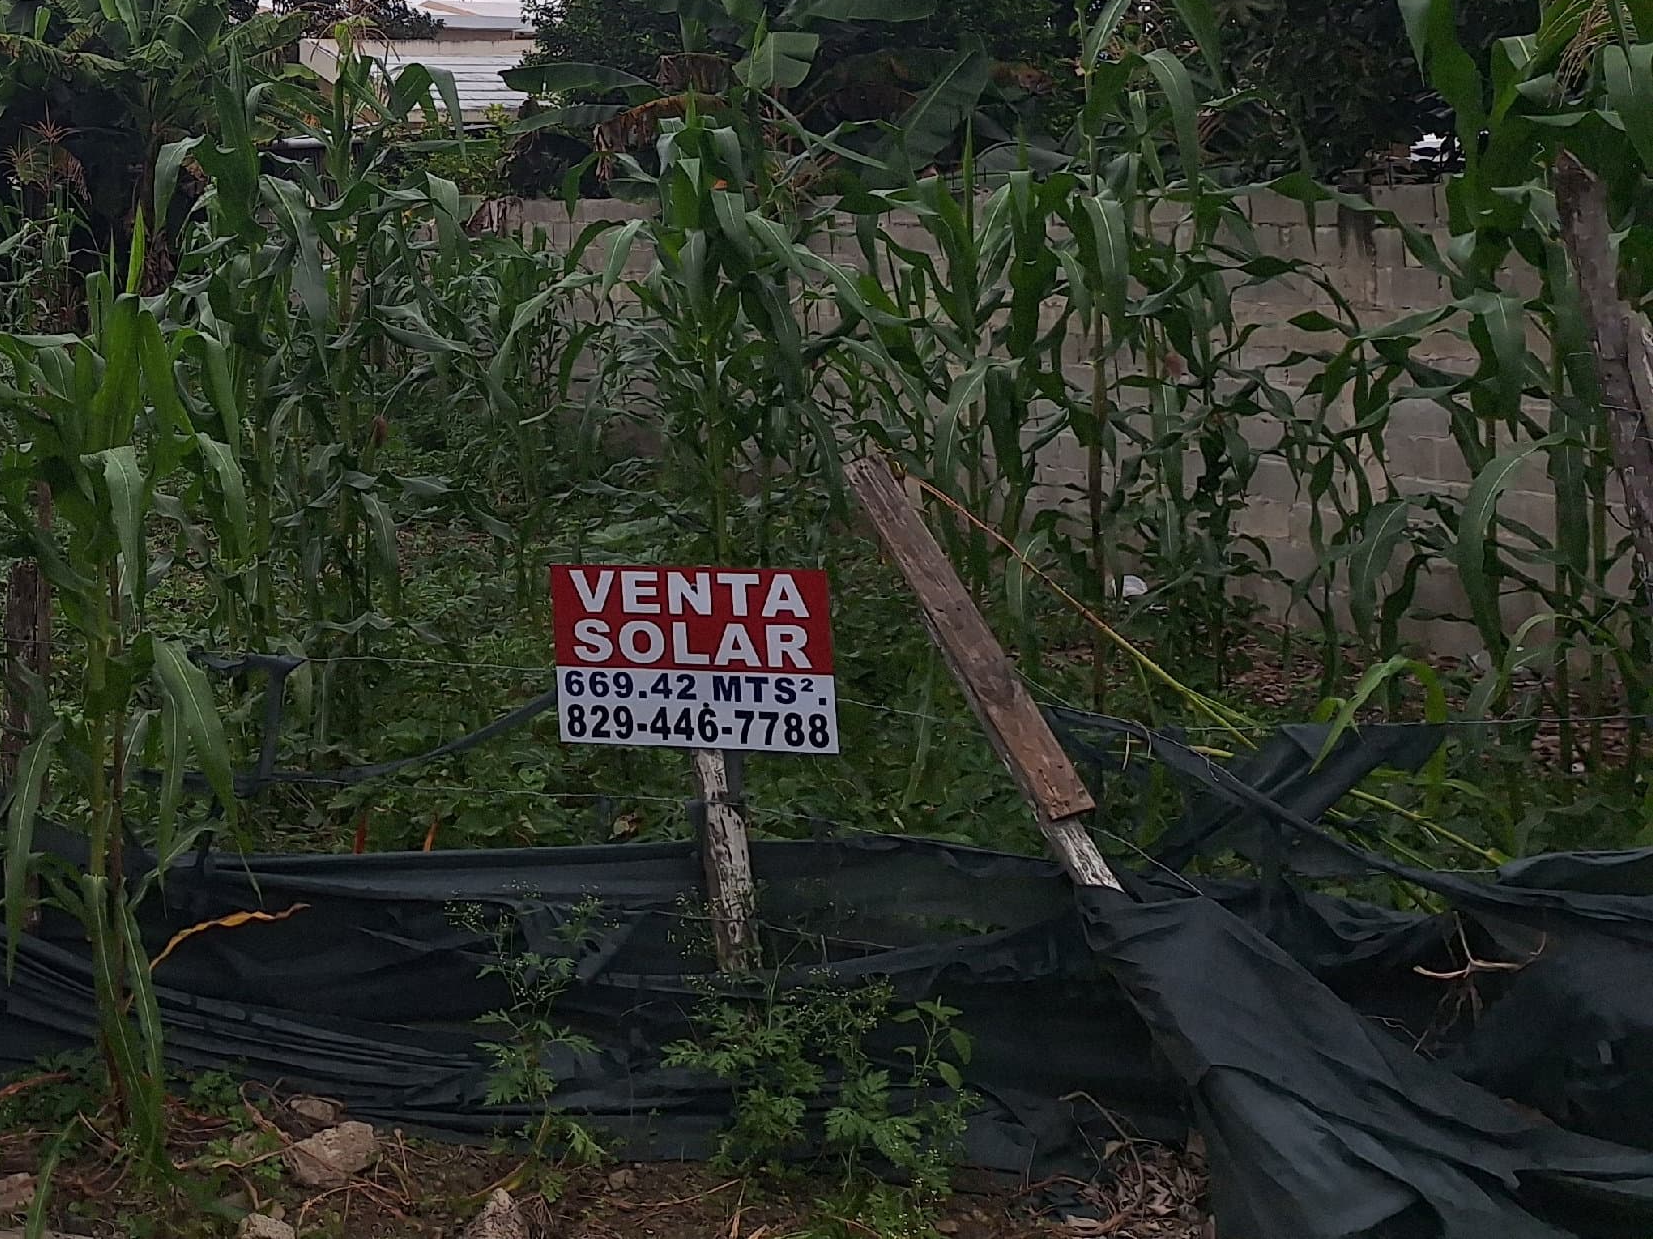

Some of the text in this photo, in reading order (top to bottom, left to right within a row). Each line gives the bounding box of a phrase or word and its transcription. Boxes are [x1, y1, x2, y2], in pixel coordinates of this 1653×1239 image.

[568, 569, 810, 618] VENTA
[573, 618, 813, 669] SOLAR
[564, 670, 697, 700] 669.42
[566, 703, 830, 749] 829-446-7788
